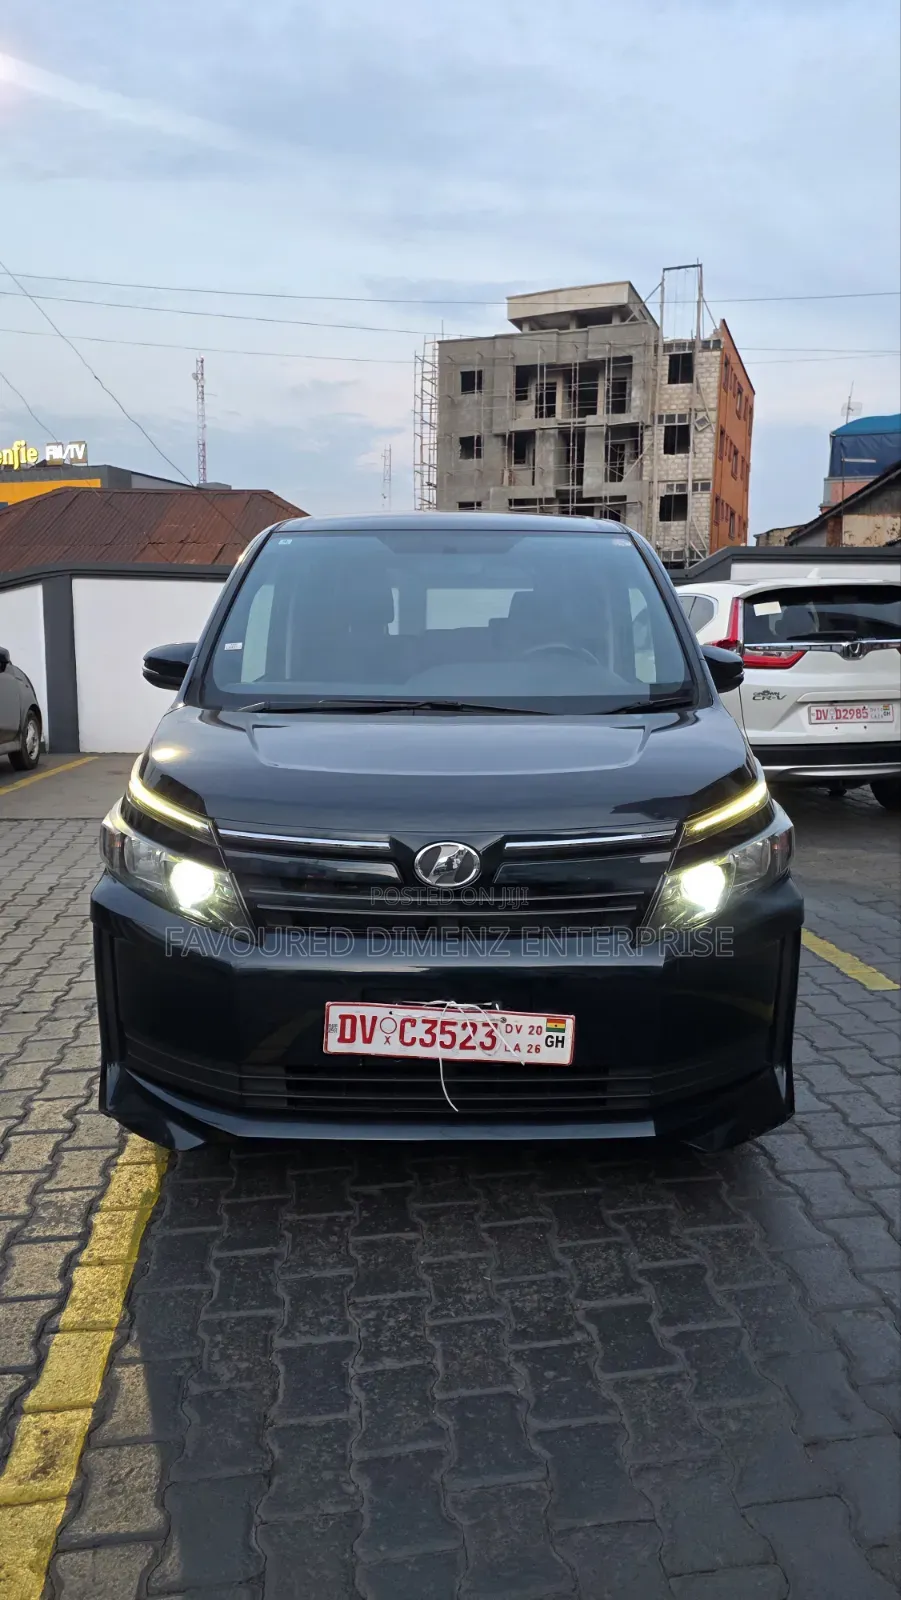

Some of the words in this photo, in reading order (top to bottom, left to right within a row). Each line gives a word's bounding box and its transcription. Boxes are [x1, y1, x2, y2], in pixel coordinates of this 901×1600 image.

[0, 440, 38, 470] nfie
[815, 709, 829, 720] DV
[835, 708, 869, 720] D2985
[337, 1014, 377, 1044] DV
[399, 1017, 498, 1051] C3523
[505, 1023, 523, 1034] DV
[528, 1025, 543, 1036] 20
[527, 1043, 541, 1054] 26
[544, 1034, 565, 1049] GH
